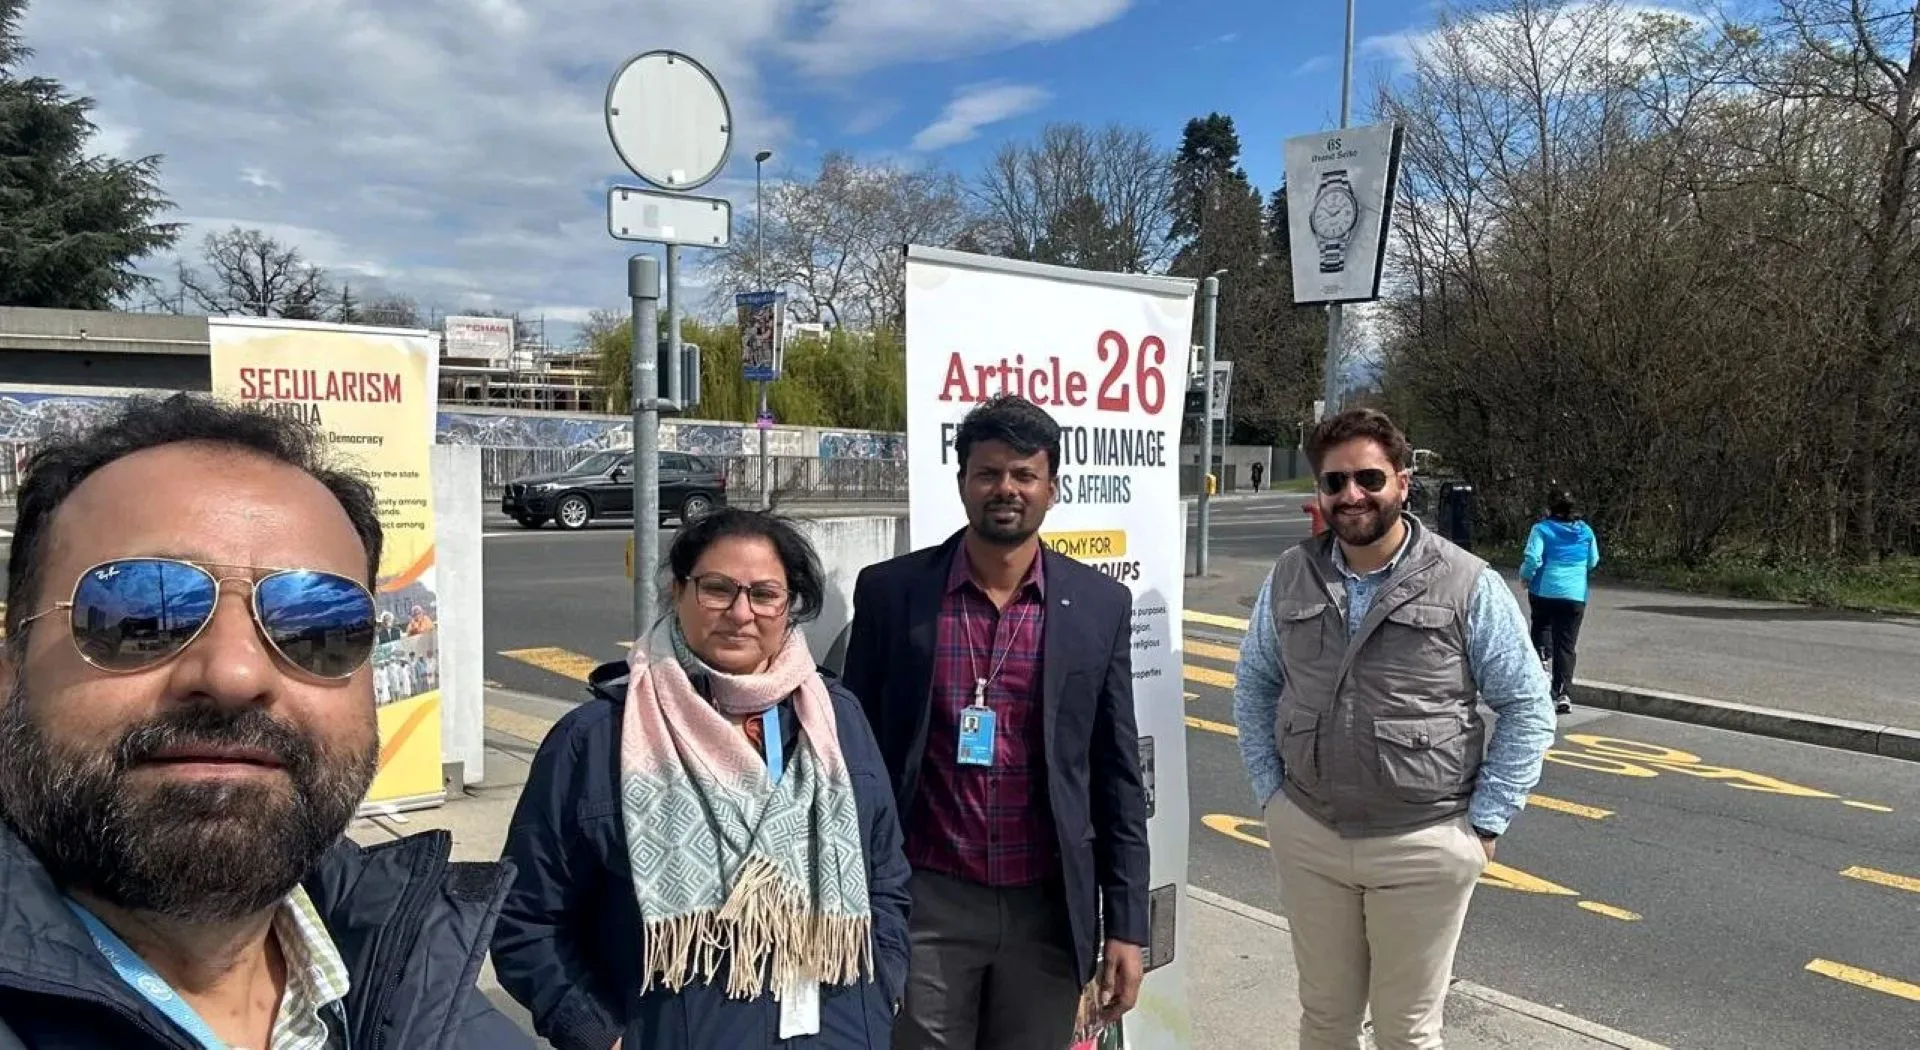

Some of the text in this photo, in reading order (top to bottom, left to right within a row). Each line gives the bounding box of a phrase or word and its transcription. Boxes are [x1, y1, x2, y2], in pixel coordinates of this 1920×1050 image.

[939, 330, 1166, 416] Article 26
[240, 368, 403, 403] SECULARISM
[329, 431, 384, 446] Democracy
[1060, 426, 1166, 467] TO MANAGE
[383, 470, 398, 478] the
[399, 470, 419, 478] state
[1078, 475, 1132, 504] AFFAIRS
[399, 498, 428, 507] among
[396, 521, 425, 530] among
[1089, 536, 1112, 554] FOR
